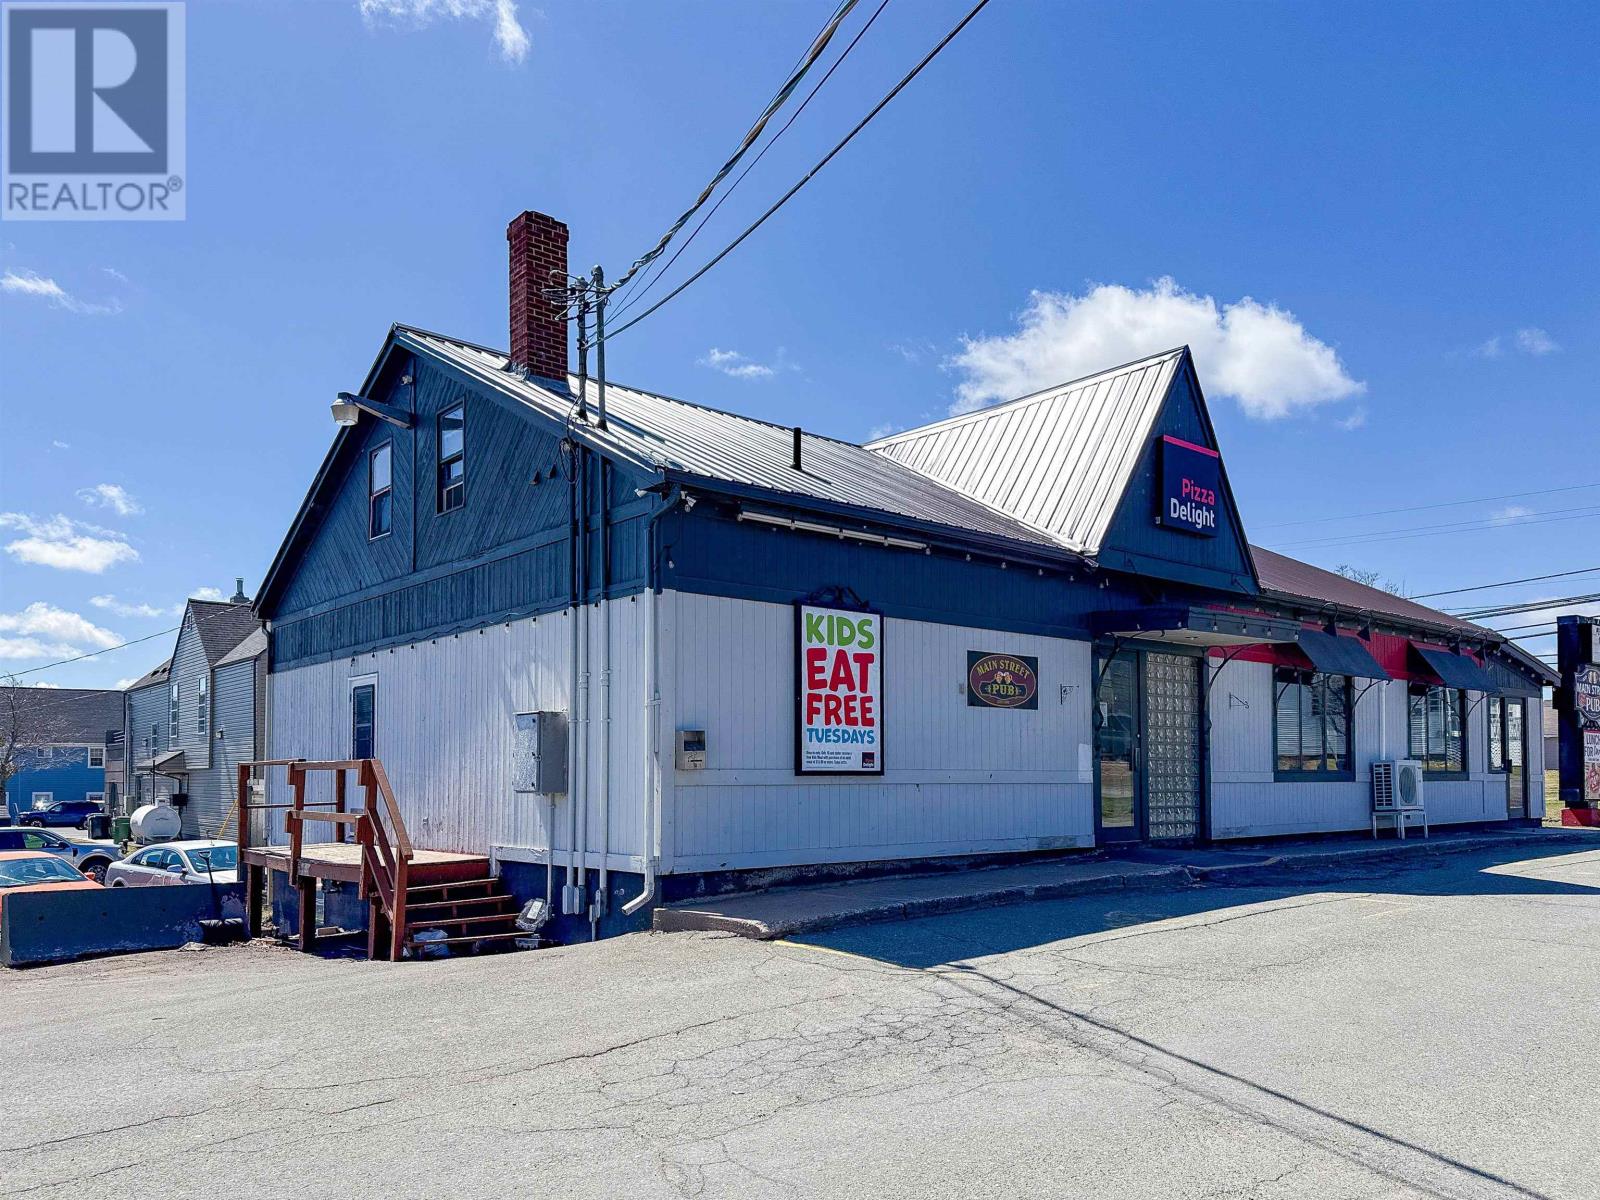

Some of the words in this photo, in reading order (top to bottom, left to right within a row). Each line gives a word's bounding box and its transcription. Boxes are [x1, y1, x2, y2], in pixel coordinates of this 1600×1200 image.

[1182, 478, 1215, 505] Pizza
[1170, 497, 1215, 528] Delight
[805, 612, 875, 649] KIDS
[806, 647, 875, 694] EAT
[976, 660, 998, 676] MAIN
[1000, 659, 1030, 679] STREET
[992, 683, 1015, 696] PUB
[1576, 683, 1591, 694] MAIN
[806, 692, 875, 727] FREE
[1586, 697, 1600, 712] PUB
[806, 727, 875, 745] TUESDAYS
